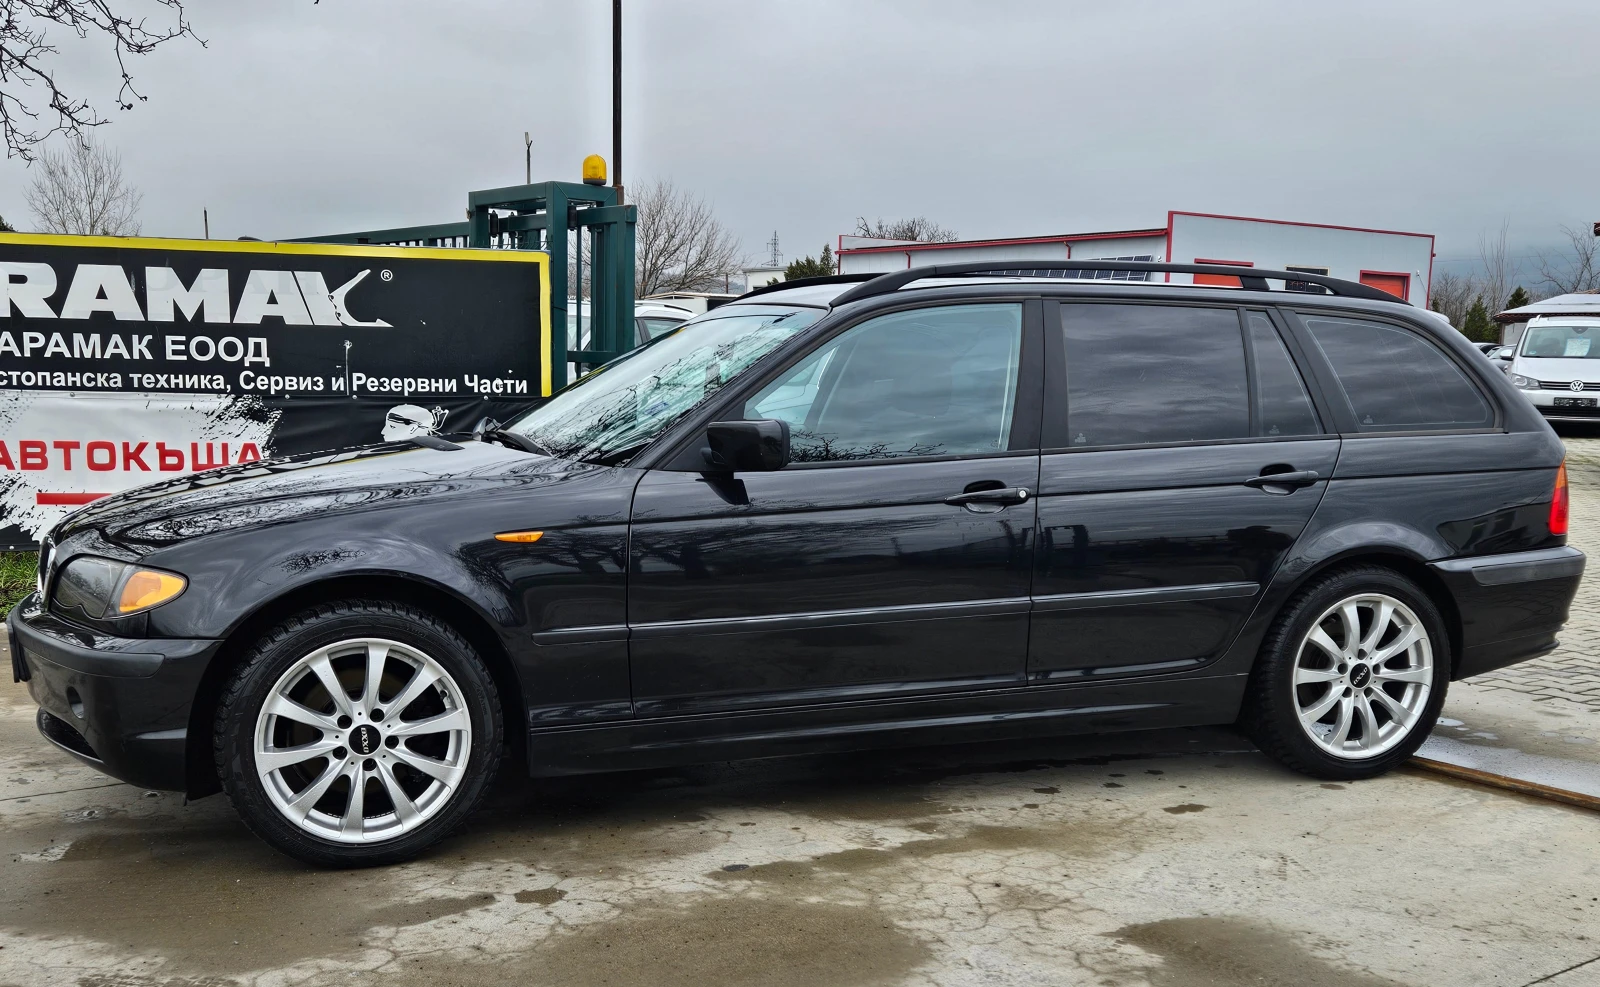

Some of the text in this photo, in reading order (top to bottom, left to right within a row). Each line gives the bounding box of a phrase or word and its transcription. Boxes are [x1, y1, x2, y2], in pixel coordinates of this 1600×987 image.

[0, 331, 271, 367] АРАМАК ЕООД
[129, 373, 231, 392] техника,
[239, 371, 324, 395] Сервиз
[331, 377, 345, 391] и
[352, 373, 457, 396] Резервни
[464, 375, 528, 394] Части
